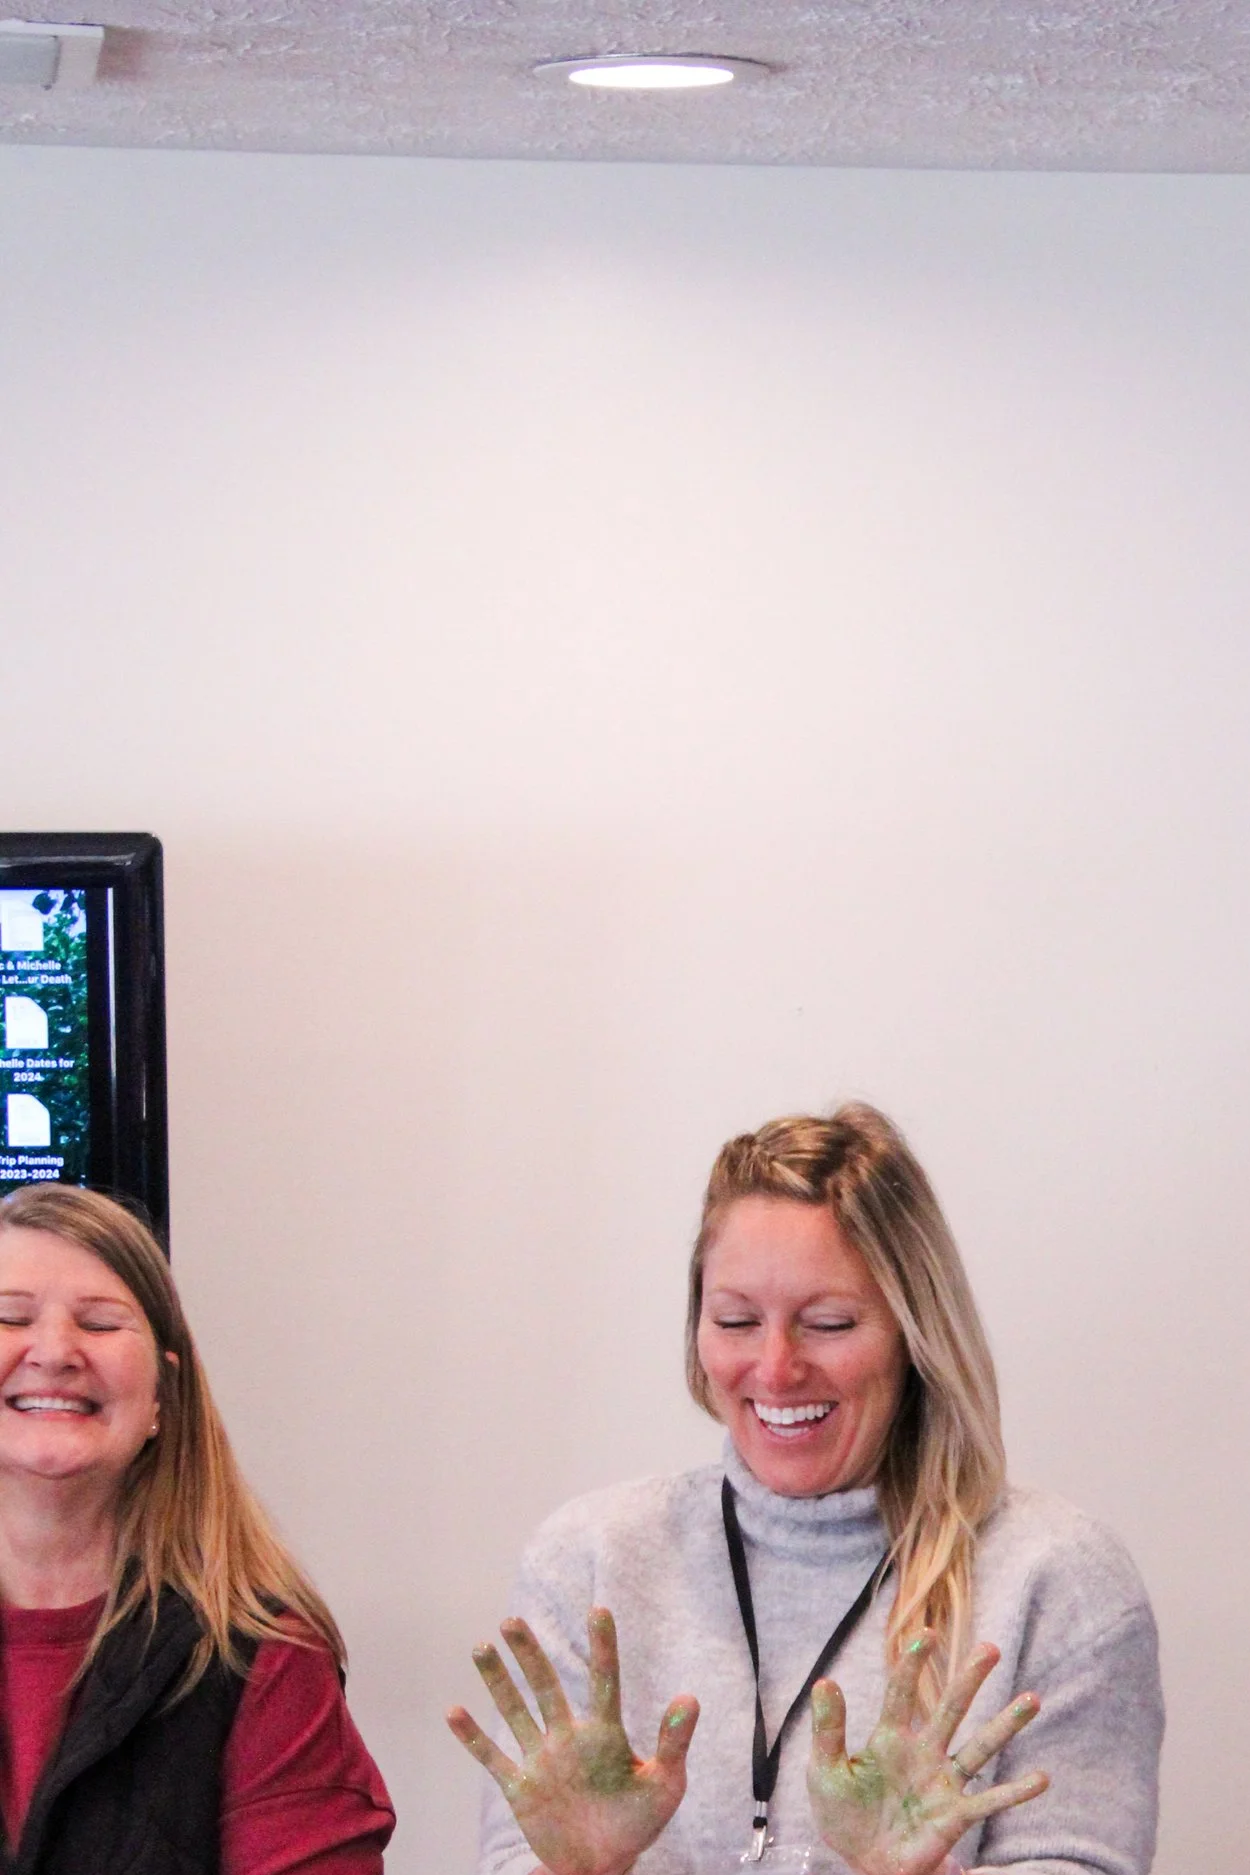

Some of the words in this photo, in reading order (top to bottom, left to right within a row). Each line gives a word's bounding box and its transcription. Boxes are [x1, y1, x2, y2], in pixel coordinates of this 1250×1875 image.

[7, 960, 15, 971] &
[16, 960, 62, 971] Michelle
[40, 974, 73, 985] Death
[26, 1058, 58, 1069] Dates
[58, 1058, 75, 1069] for
[13, 1072, 44, 1082] 2024
[17, 1154, 65, 1168] Planning
[0, 1168, 60, 1180] 2023-2024
